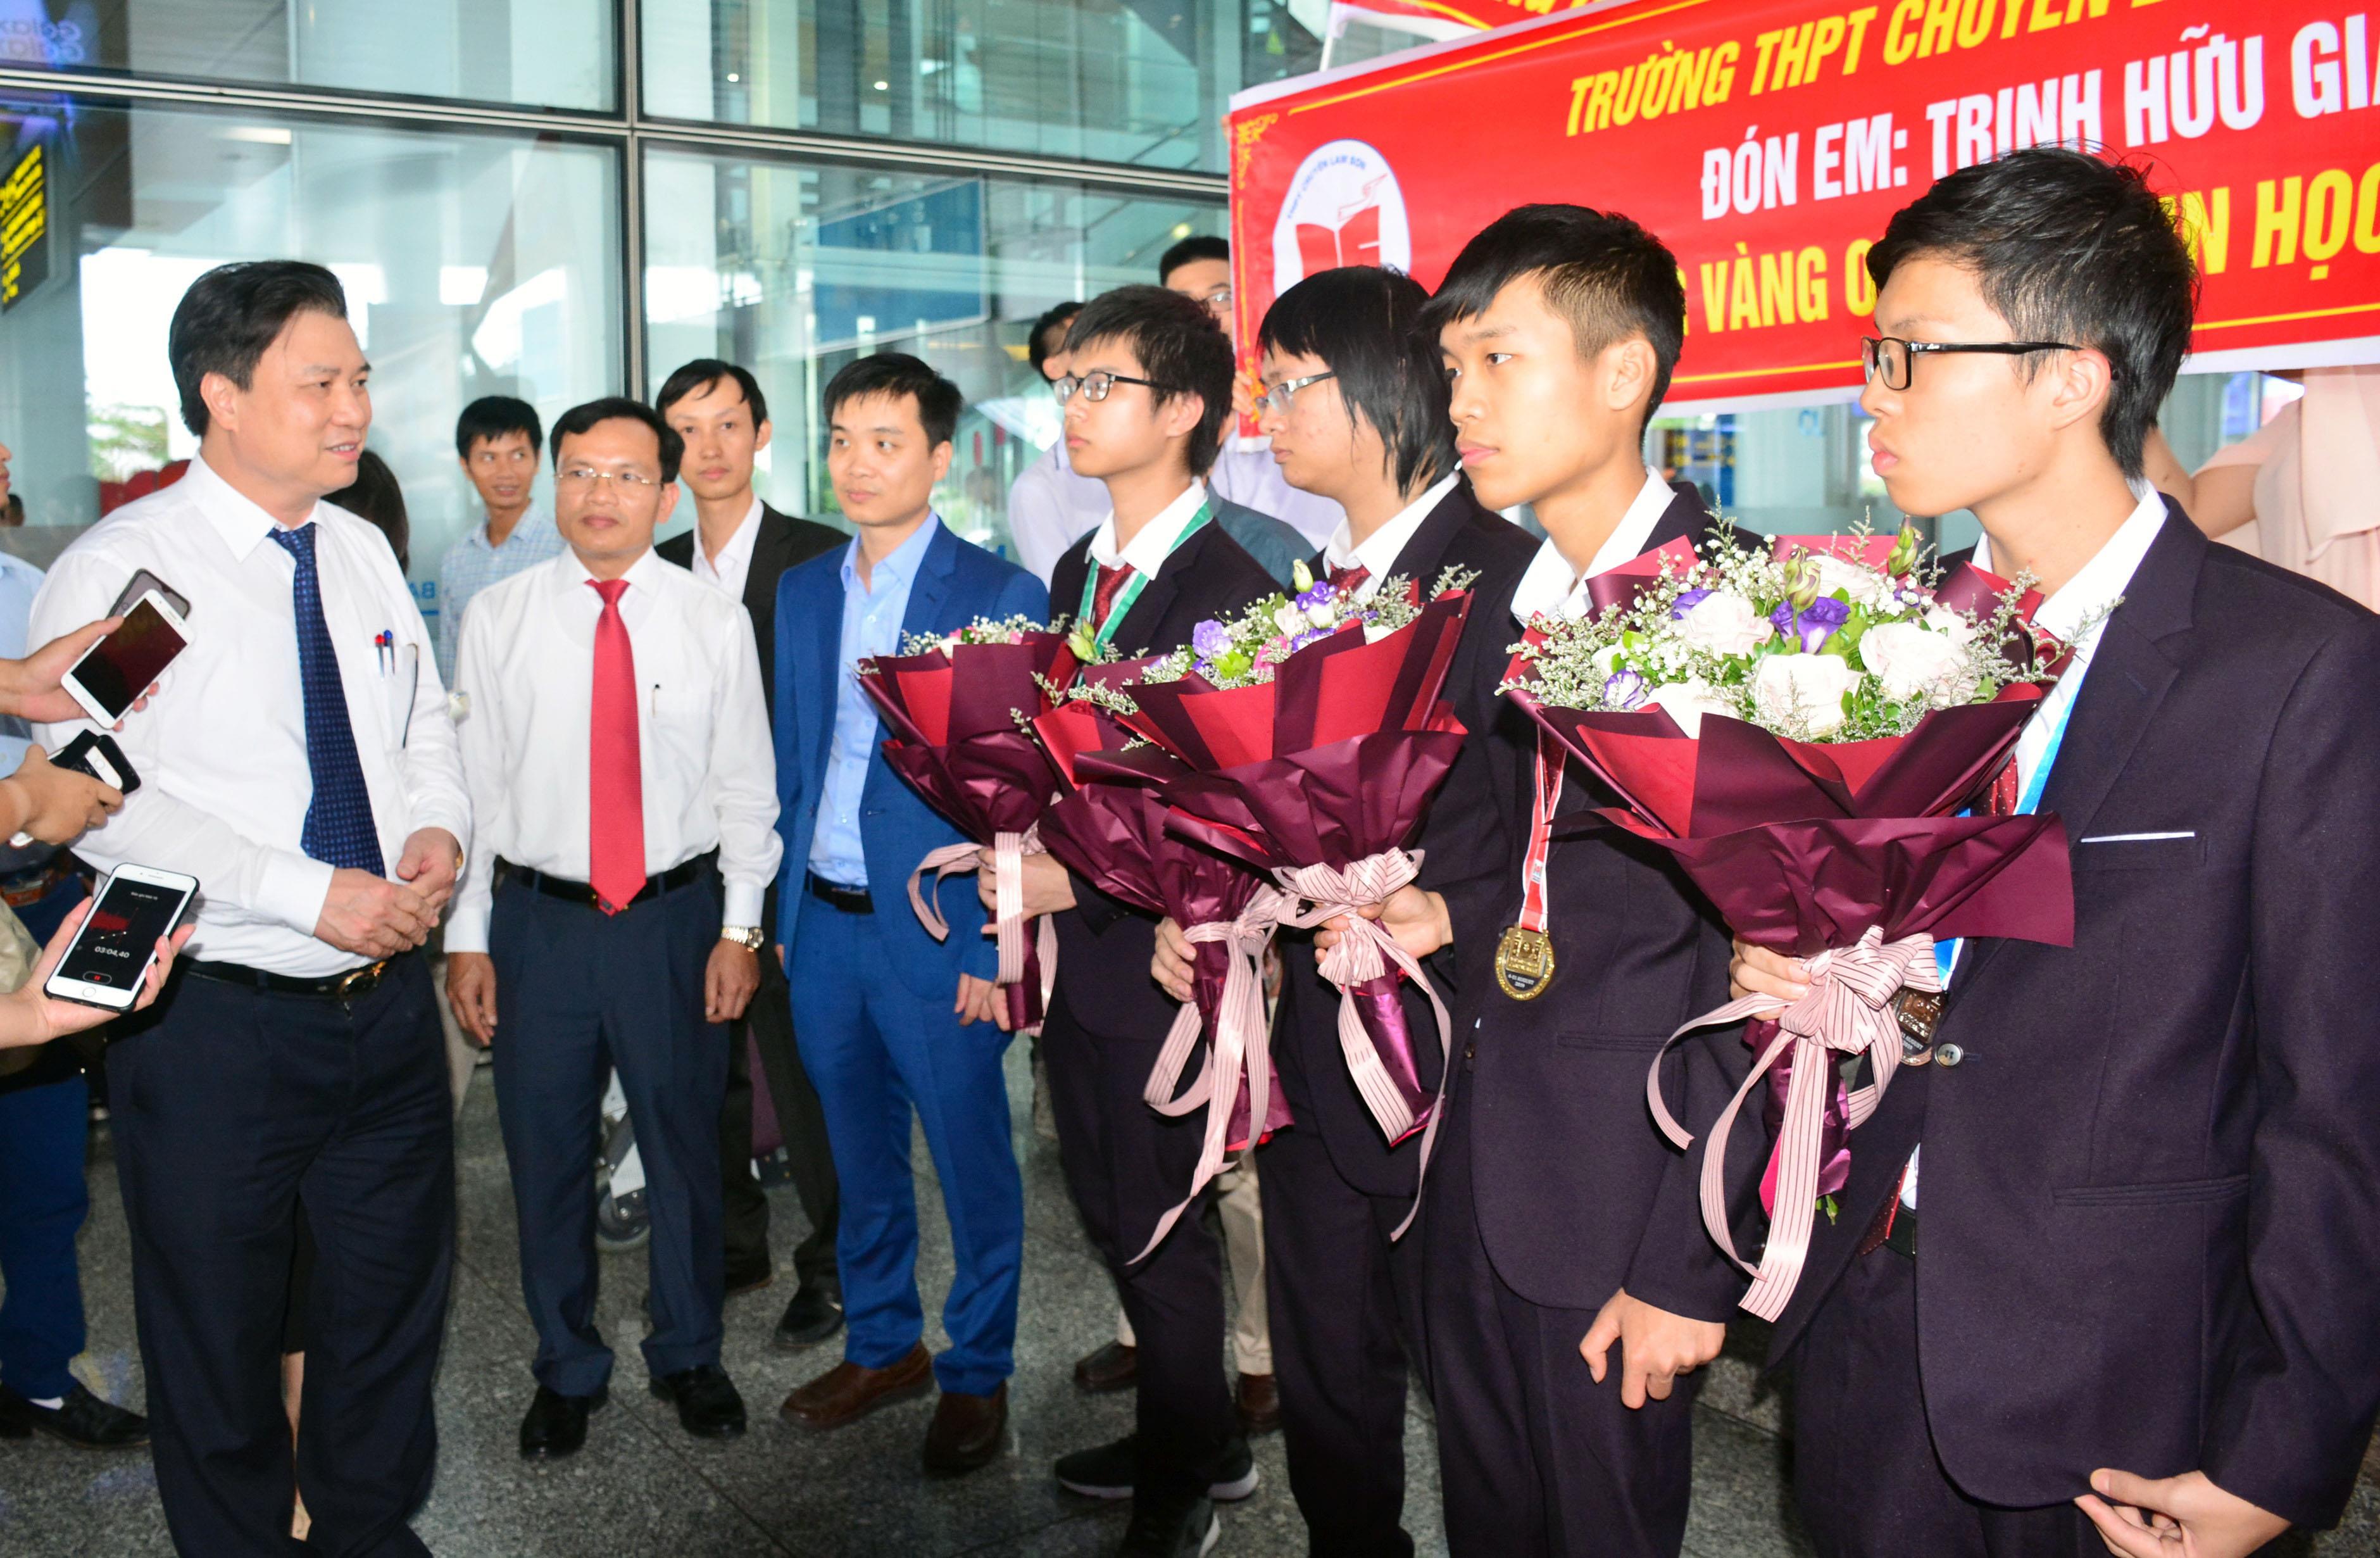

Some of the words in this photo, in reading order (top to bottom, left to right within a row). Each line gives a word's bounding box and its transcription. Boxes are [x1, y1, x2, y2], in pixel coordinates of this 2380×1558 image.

[1566, 42, 1741, 136] TRƯỜNG
[1750, 6, 1878, 95] THPT
[1701, 126, 1799, 220] ĐÓN
[1813, 114, 1907, 201] EM:
[2125, 23, 2264, 147] HỮU
[2291, 14, 2380, 118] GI
[1700, 242, 1829, 334] VÀNG
